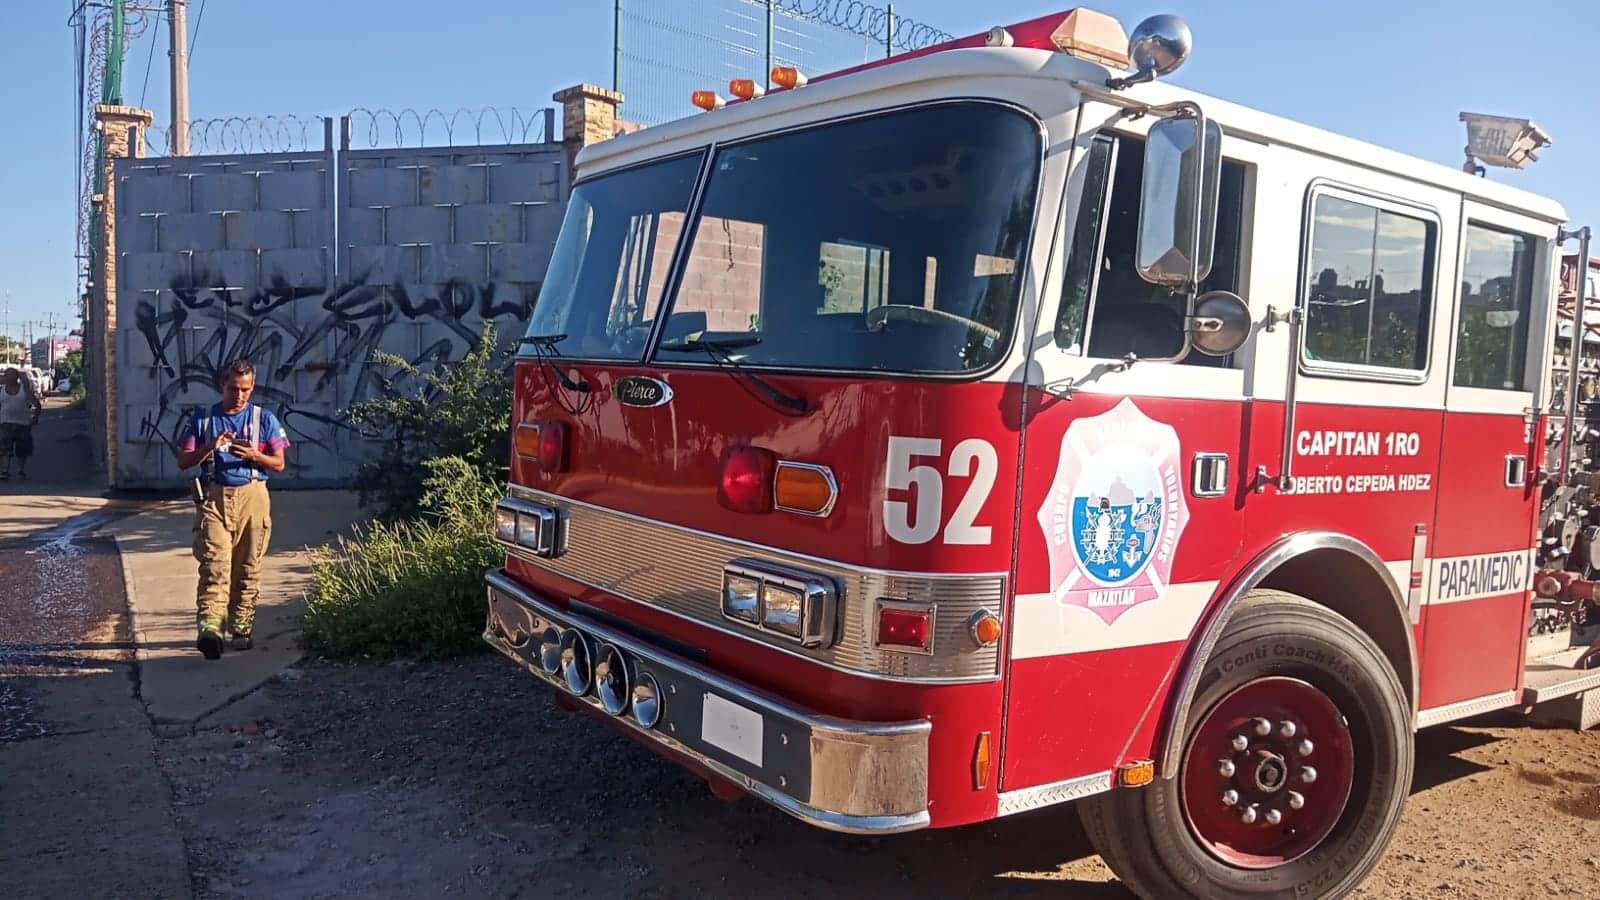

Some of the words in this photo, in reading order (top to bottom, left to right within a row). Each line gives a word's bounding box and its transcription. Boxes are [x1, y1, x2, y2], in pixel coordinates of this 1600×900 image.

[622, 379, 656, 400] Pierce
[1296, 430, 1380, 456] CAPITAN
[1385, 432, 1420, 456] 1RO
[882, 435, 999, 545] 52
[1276, 475, 1342, 495] OBERTO
[1346, 475, 1395, 493] CEPEDA
[1398, 474, 1431, 490] HDEZ
[1438, 554, 1522, 600] PARAMEDIC
[1222, 645, 1267, 673] Conti
[1273, 643, 1325, 664] Coach
